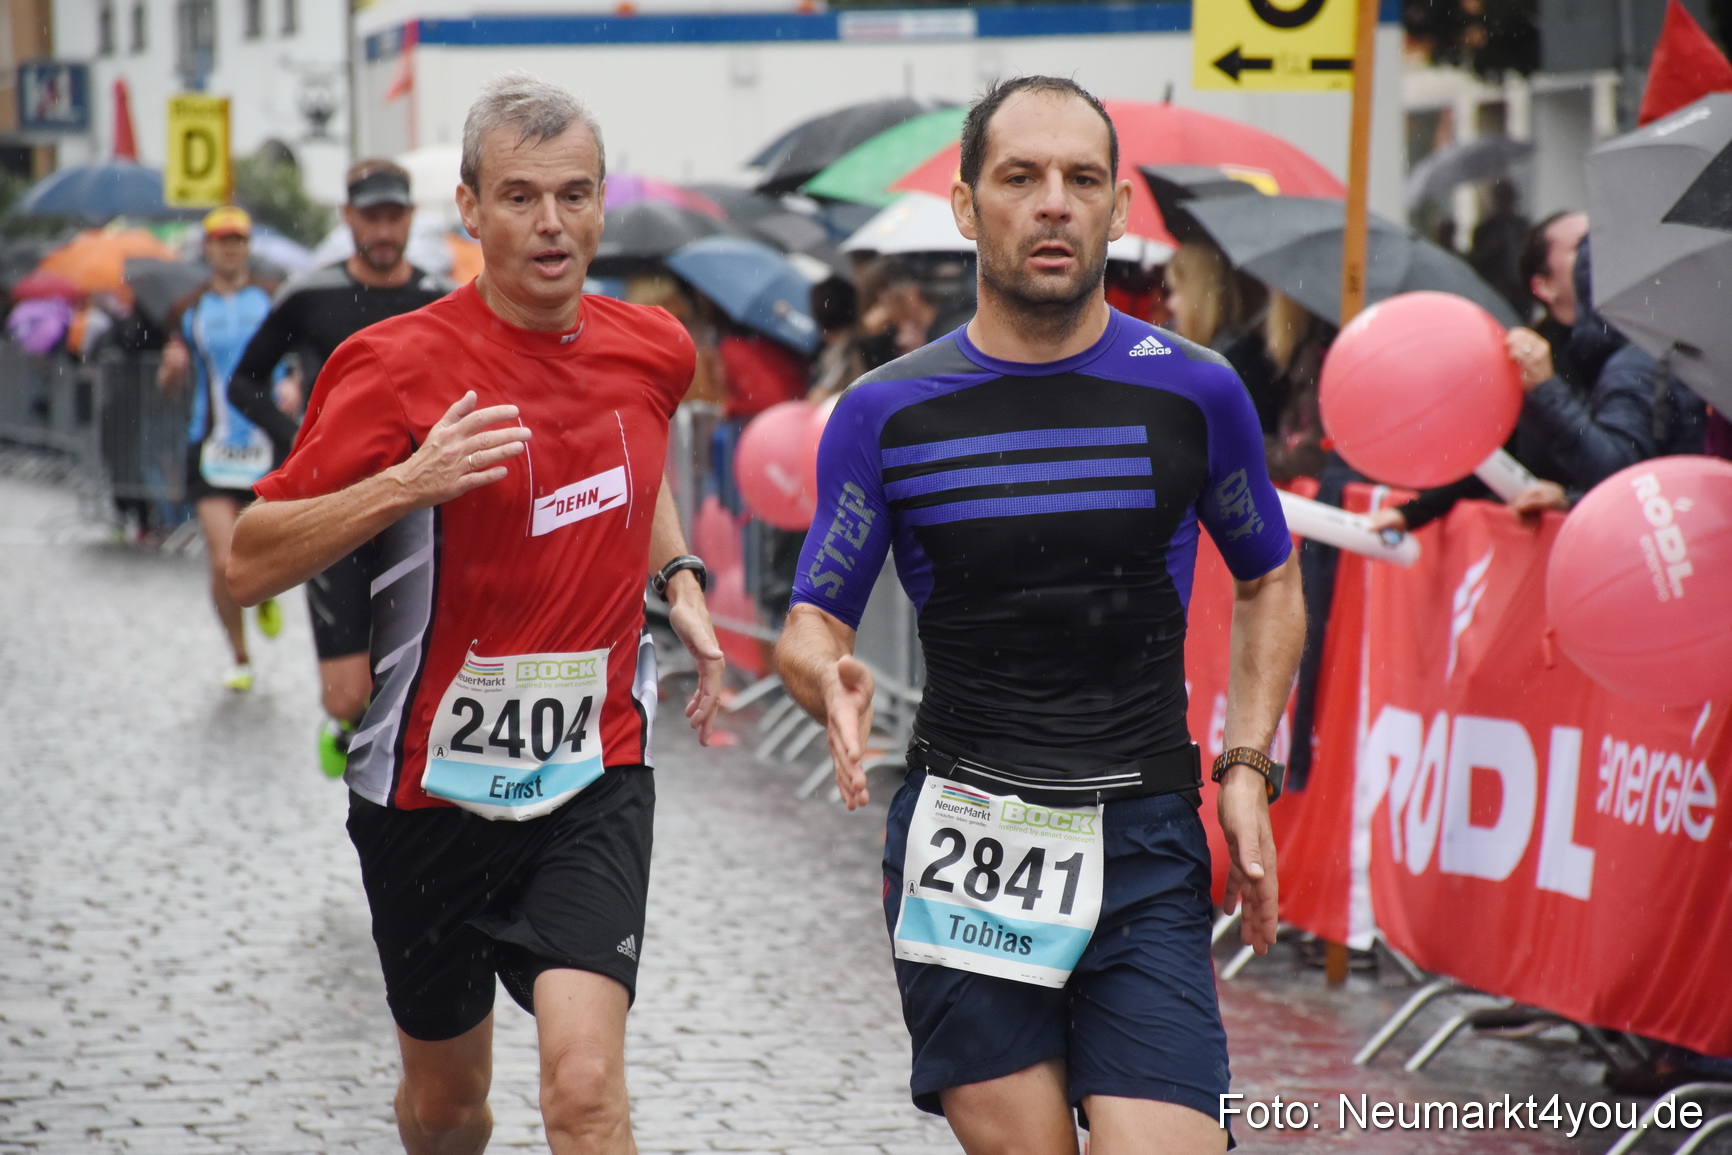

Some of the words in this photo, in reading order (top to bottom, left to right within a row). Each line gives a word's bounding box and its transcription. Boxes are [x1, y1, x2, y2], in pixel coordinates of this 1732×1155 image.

[182, 127, 217, 180] D
[1128, 346, 1172, 357] adidas
[556, 487, 600, 517] DEHN
[516, 658, 597, 682] BOCK
[450, 695, 594, 762] 2404
[489, 775, 544, 800] Ernst
[934, 799, 992, 822] NeuerMarkt
[1000, 800, 1097, 836] BOCK
[998, 822, 1029, 835] inspired
[1030, 827, 1039, 837] by
[1040, 830, 1062, 840] smart
[1063, 834, 1096, 844] concepts
[919, 827, 1085, 916] 2841
[949, 914, 1033, 957] Tobias
